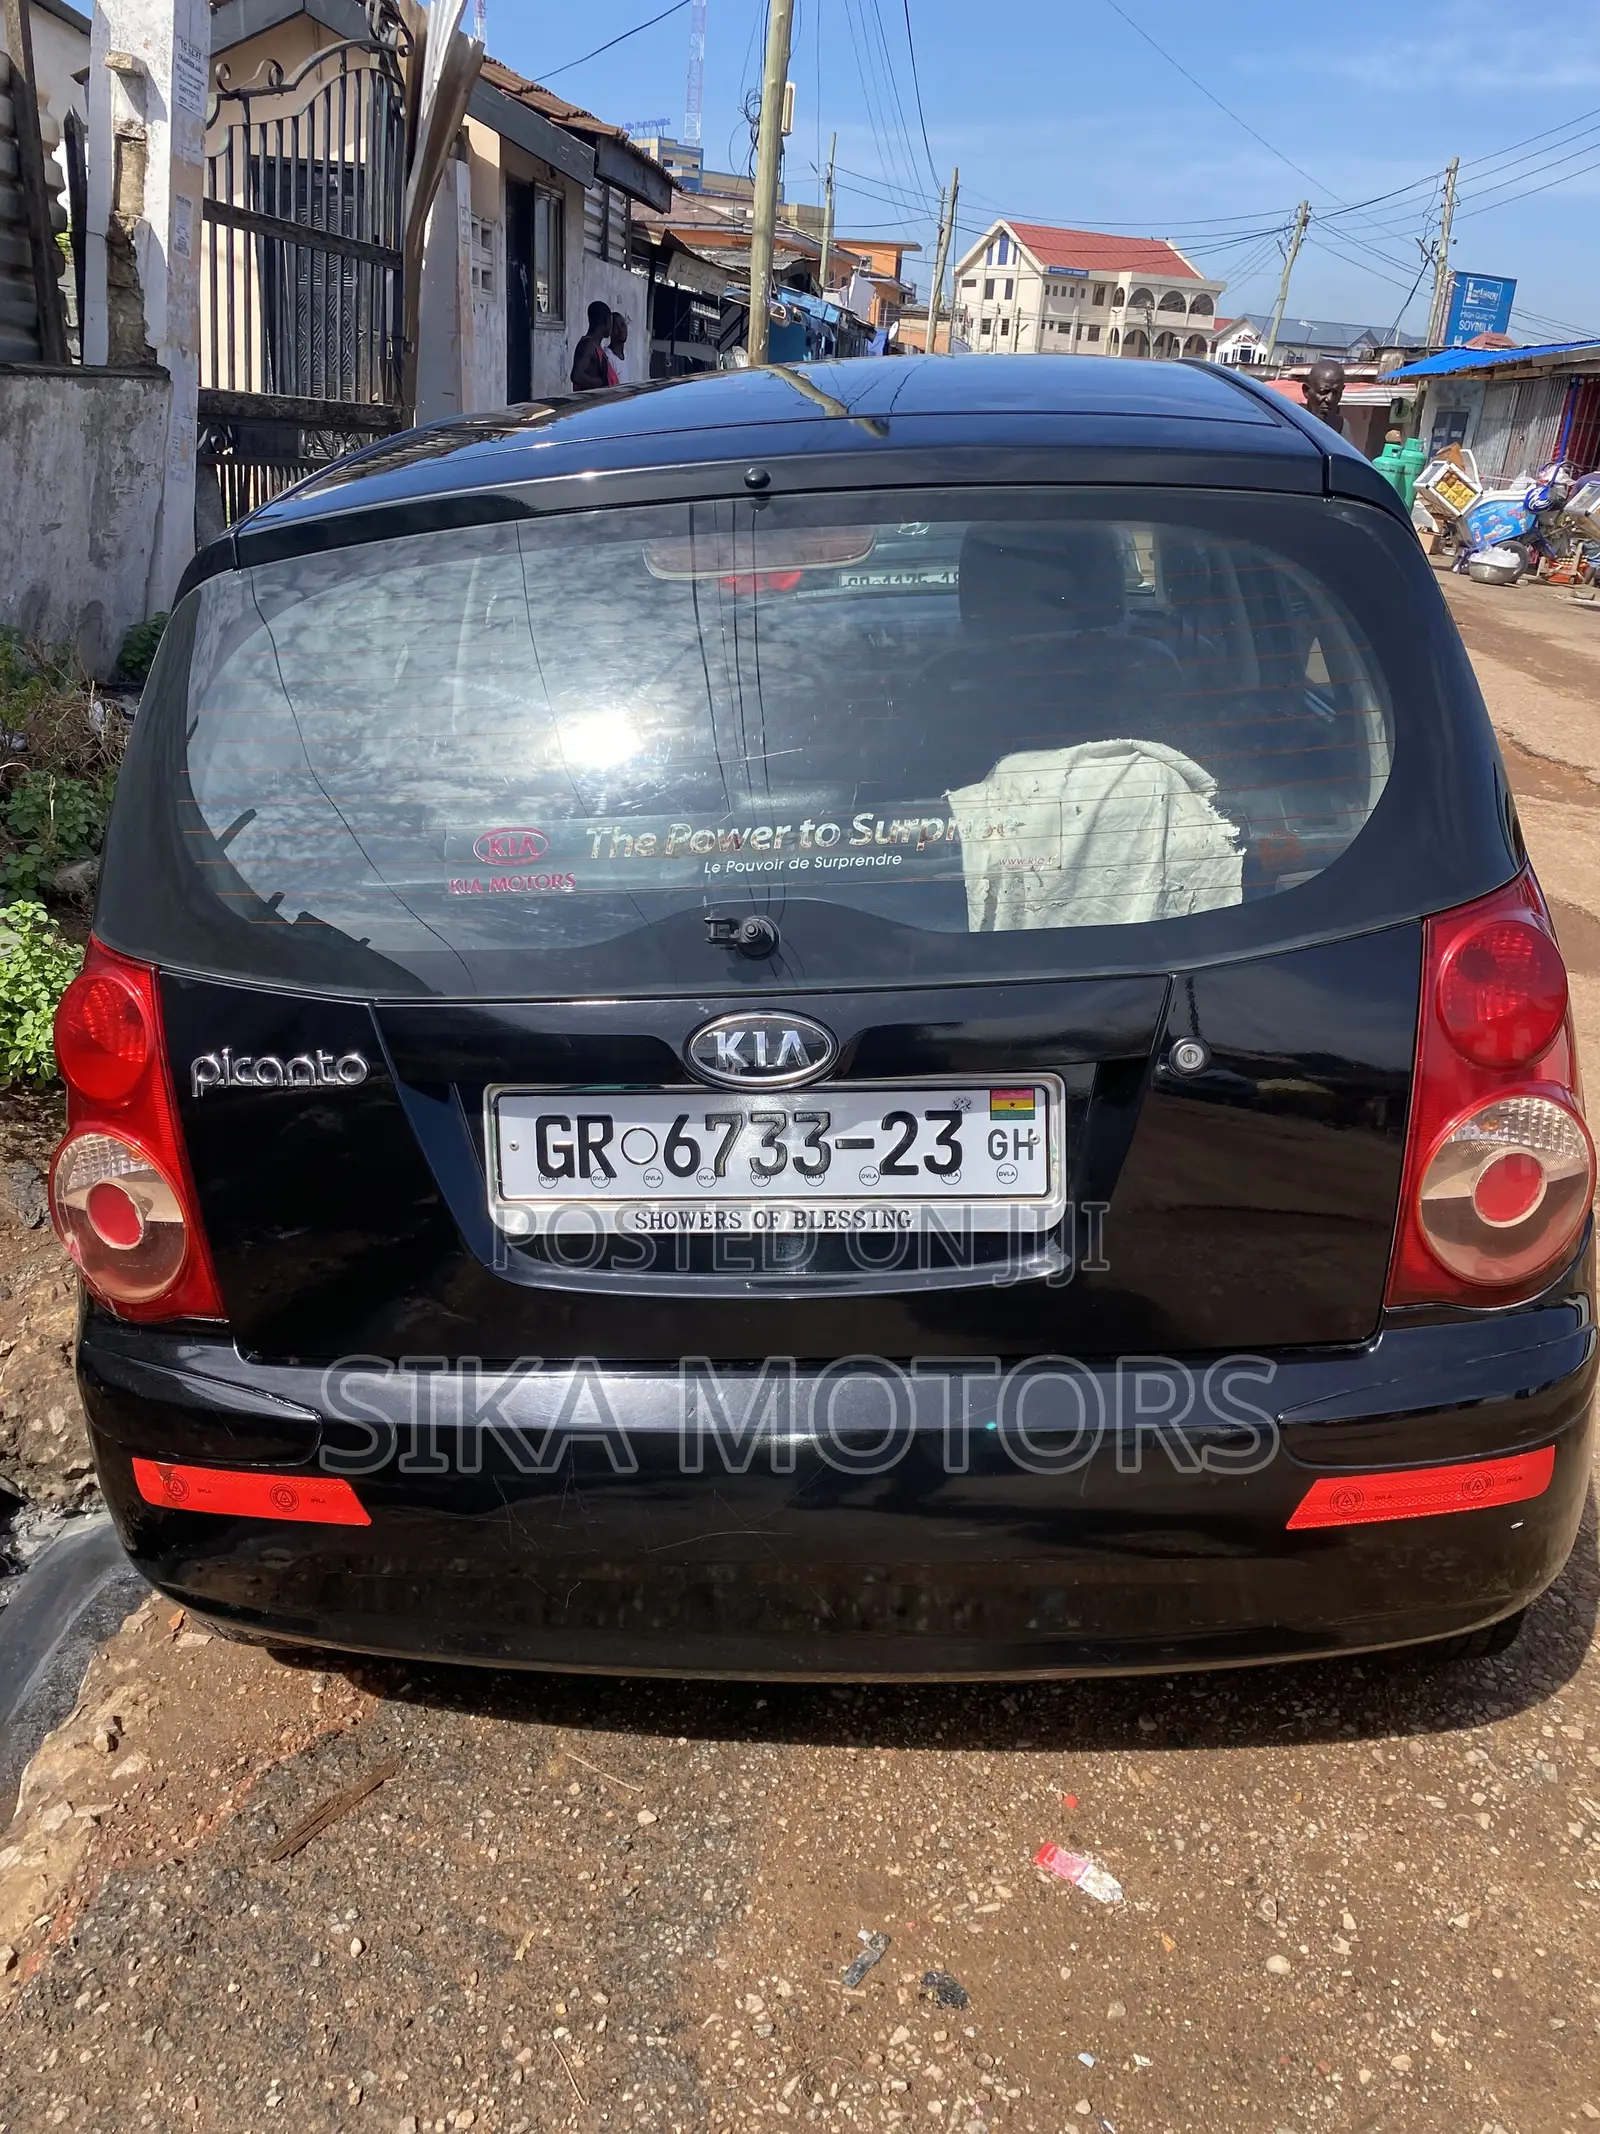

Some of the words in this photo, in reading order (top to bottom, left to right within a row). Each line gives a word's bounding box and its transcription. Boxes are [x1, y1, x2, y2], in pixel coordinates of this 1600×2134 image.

[487, 835, 540, 857] KIA
[586, 826, 657, 858] The
[665, 822, 792, 855] Power
[799, 818, 841, 848] to
[703, 861, 721, 874] Le
[726, 858, 784, 872] Pouvoir
[788, 857, 810, 870] de
[814, 853, 902, 870] Surprendre
[450, 877, 482, 894] KIA
[488, 872, 577, 892] MOTORS
[713, 1029, 812, 1069] KIA
[190, 1046, 370, 1098] picanto
[987, 1128, 1034, 1161] GH
[634, 1210, 743, 1231] SHOWERS
[753, 1210, 781, 1230] OF
[793, 1209, 913, 1230] BLESSING
